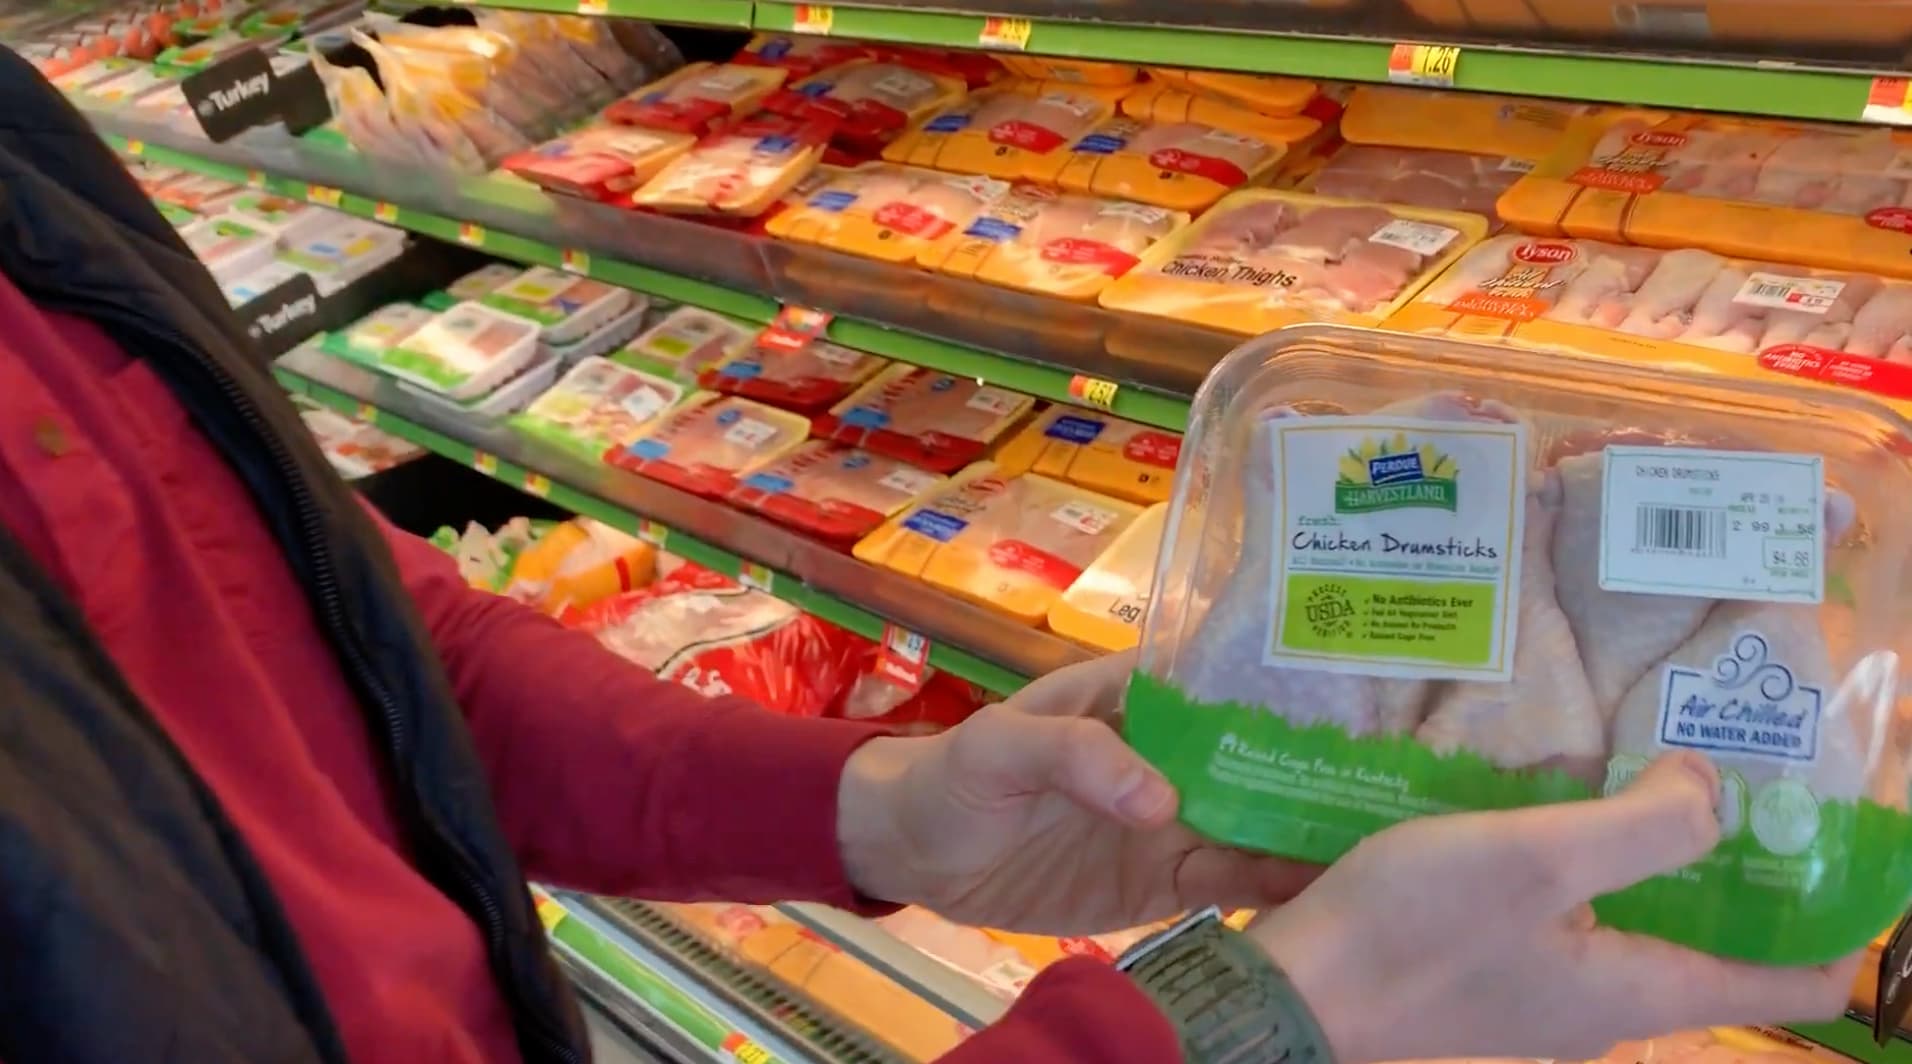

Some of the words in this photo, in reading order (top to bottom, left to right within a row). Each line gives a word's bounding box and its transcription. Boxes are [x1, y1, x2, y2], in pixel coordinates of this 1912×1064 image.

[208, 71, 270, 111] Turkey
[1520, 243, 1572, 261] Tyson
[1162, 260, 1229, 279] Chicken
[1231, 264, 1297, 287] Thighs
[255, 293, 316, 335] Turkey
[1372, 457, 1418, 475] PERDUE
[1344, 485, 1445, 506] HARVESTLAND
[1291, 530, 1371, 551] Chicken
[1381, 532, 1498, 559] Drumsticks
[1108, 597, 1141, 623] Leg
[1304, 600, 1356, 624] USDA
[1451, 596, 1474, 608] Ever
[1680, 694, 1716, 717] Air
[1718, 699, 1808, 728] Chilled
[1676, 722, 1696, 738] NO
[1699, 725, 1747, 743] WATER
[1751, 730, 1803, 748] ADDED
